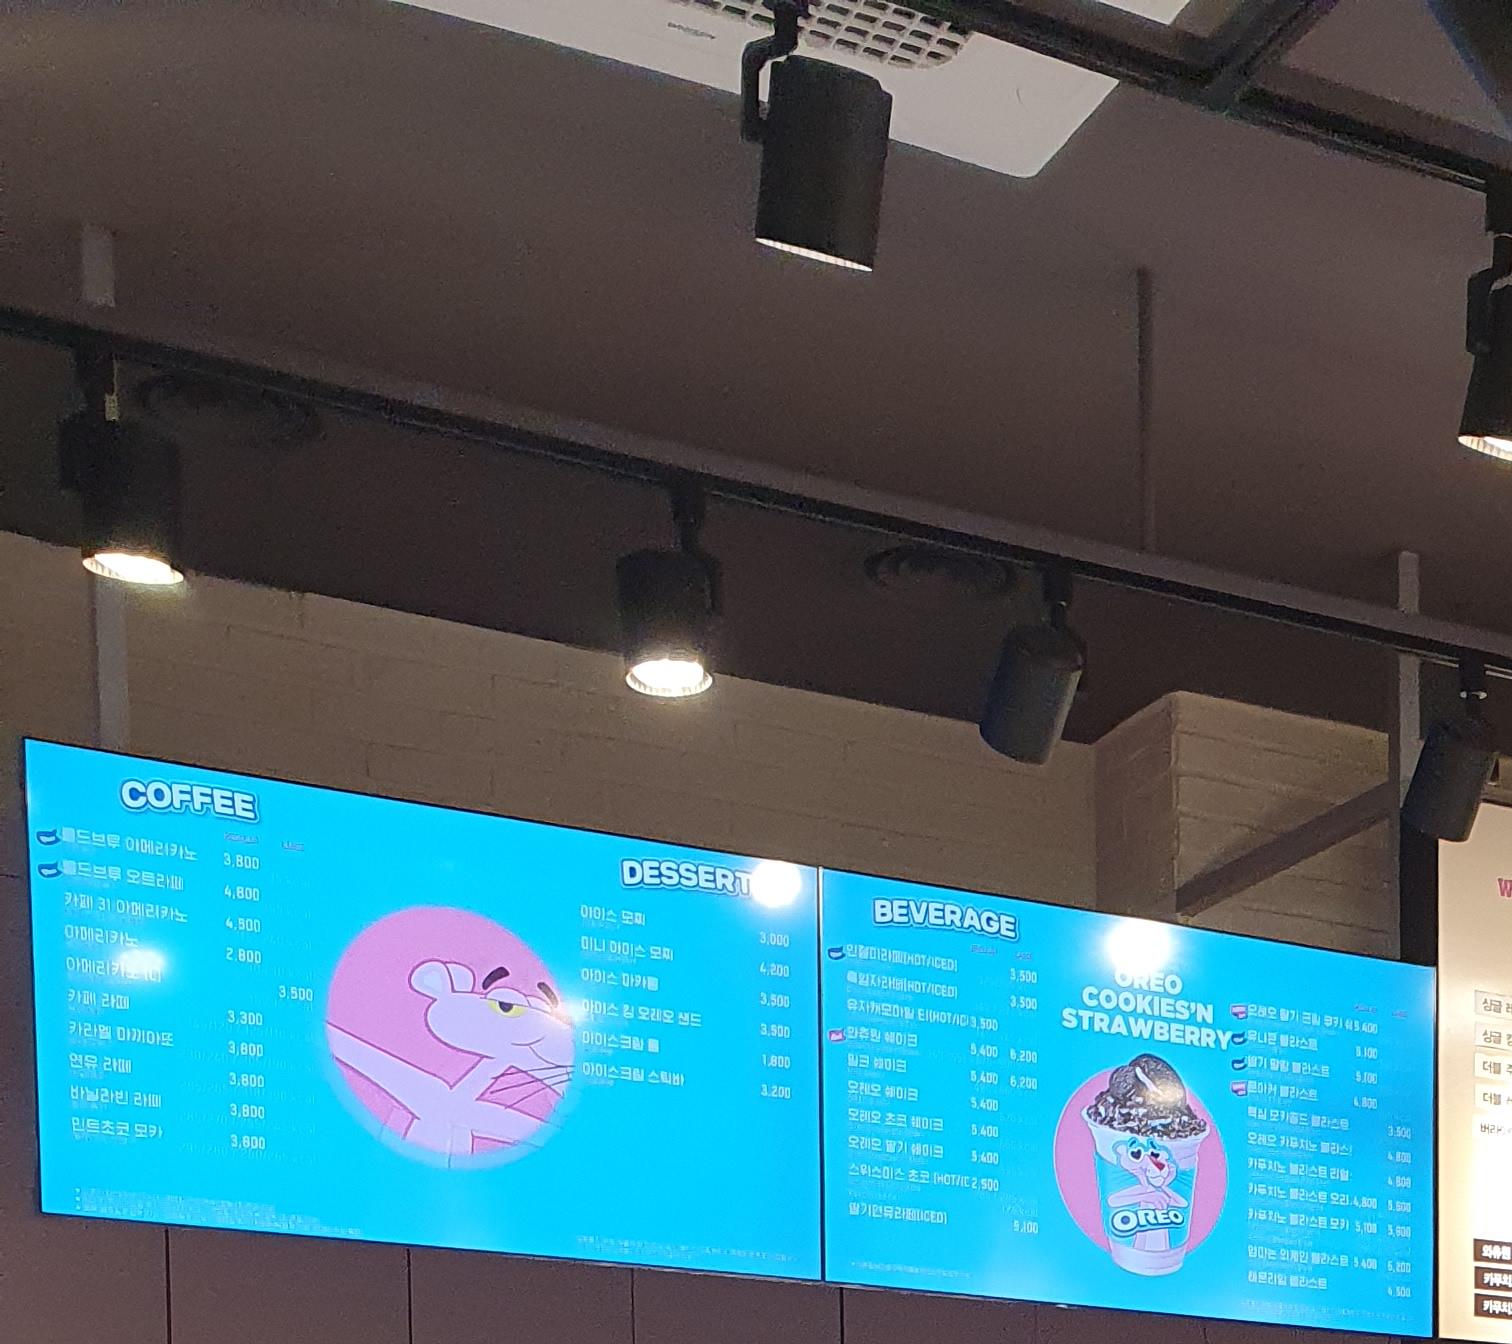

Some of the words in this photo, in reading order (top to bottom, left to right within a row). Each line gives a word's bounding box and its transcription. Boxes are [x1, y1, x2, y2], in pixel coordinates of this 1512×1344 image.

[121, 780, 256, 820] COFFEE
[873, 899, 1017, 938] BEVERAGE
[1482, 998, 1502, 1013] 싱글
[1062, 1008, 1232, 1050] STRAWBERRY
[1482, 1030, 1501, 1044] 싱글
[1113, 1209, 1184, 1232] OREO
